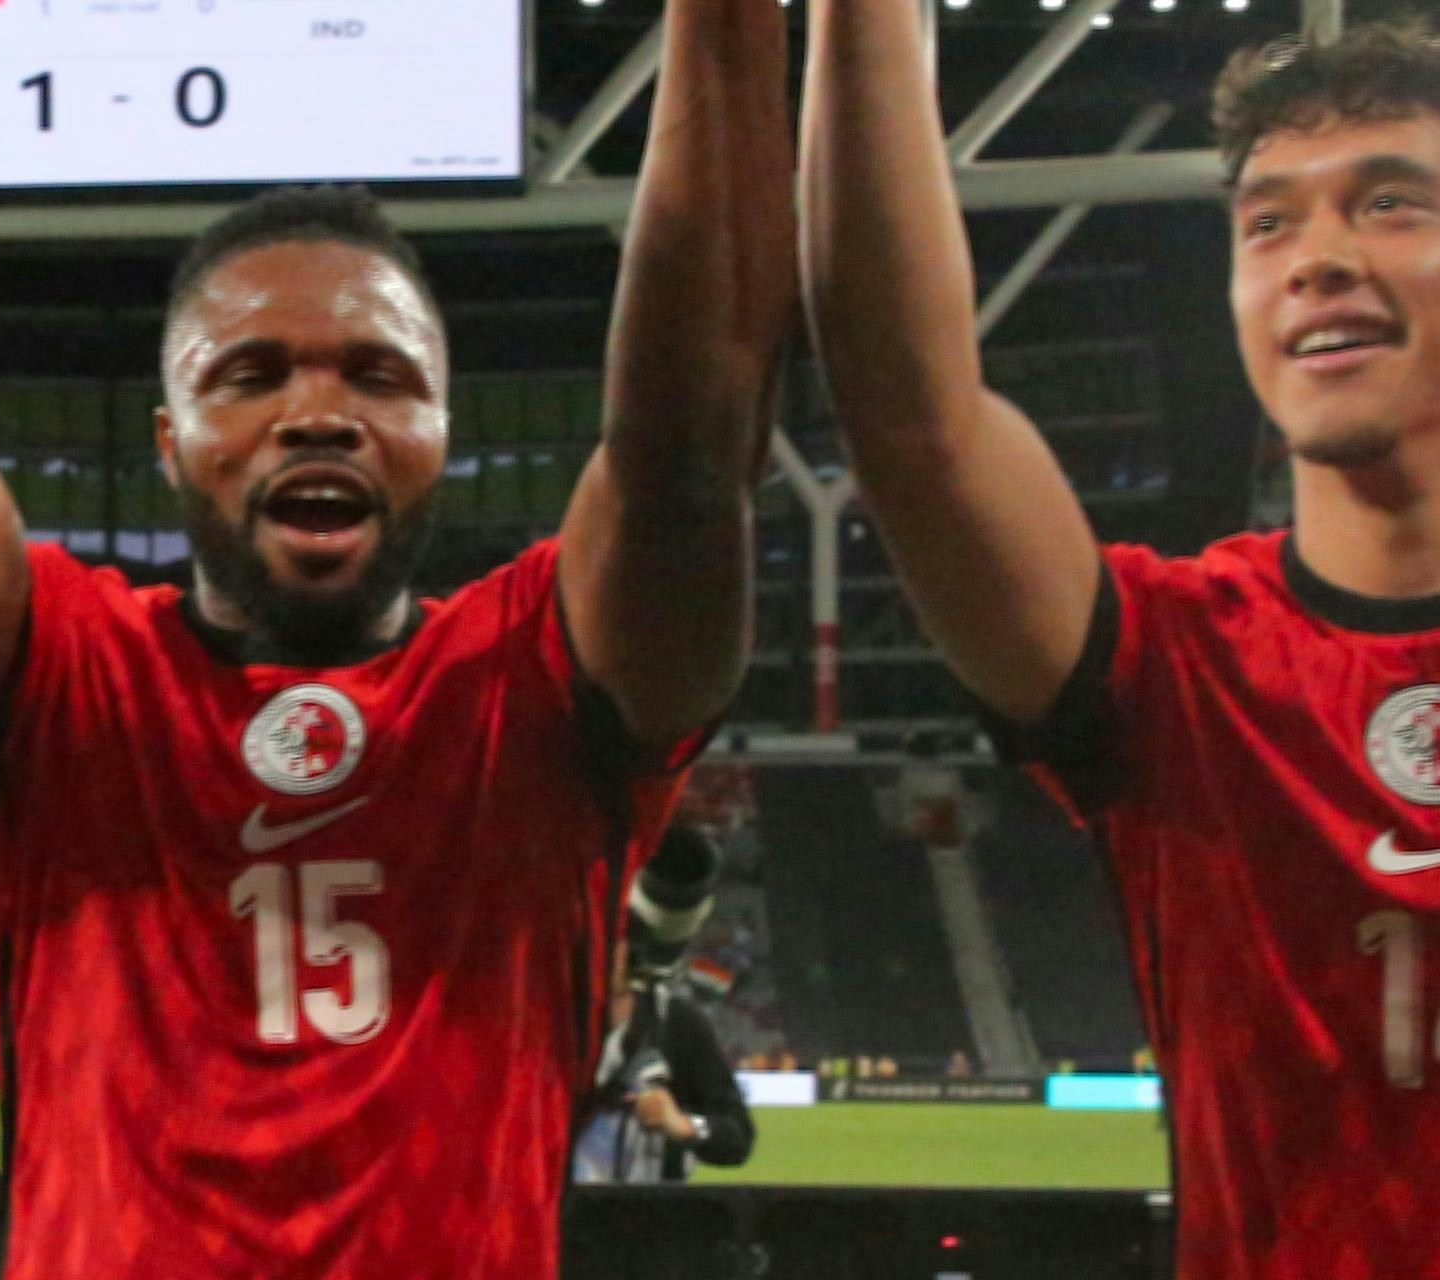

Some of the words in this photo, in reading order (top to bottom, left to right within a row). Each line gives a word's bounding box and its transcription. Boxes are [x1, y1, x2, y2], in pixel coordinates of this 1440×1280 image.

[310, 19, 366, 41] IND
[20, 71, 55, 132] 1
[175, 66, 227, 127] 0
[228, 859, 393, 1046] 15
